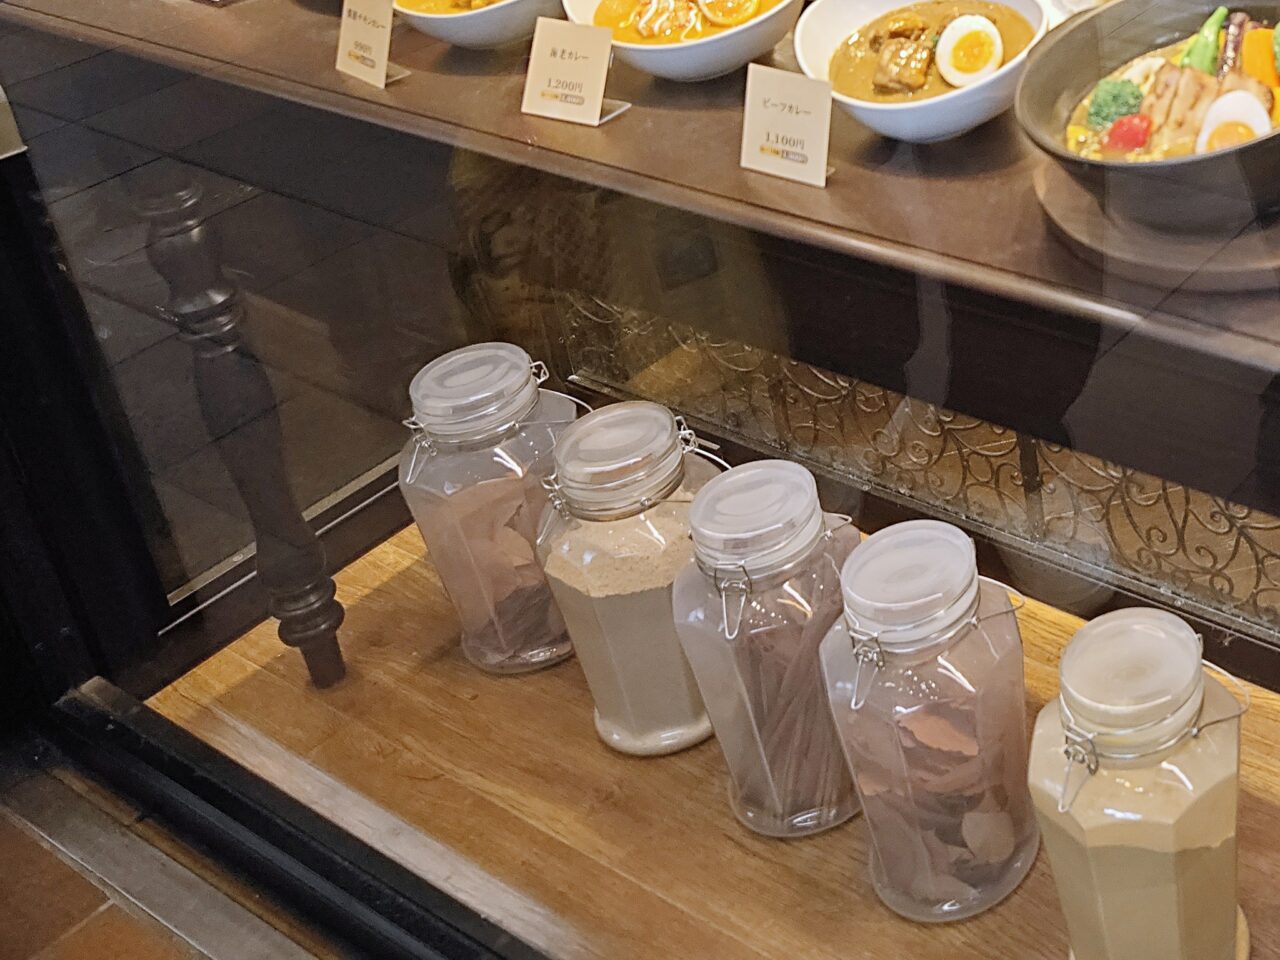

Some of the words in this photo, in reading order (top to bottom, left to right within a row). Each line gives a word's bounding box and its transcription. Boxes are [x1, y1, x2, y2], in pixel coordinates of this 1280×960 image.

[550, 47, 591, 61] 海老カレー
[547, 78, 583, 93] 1,200円
[763, 97, 812, 115] ビーフカレー
[766, 131, 805, 150] 1,100円
